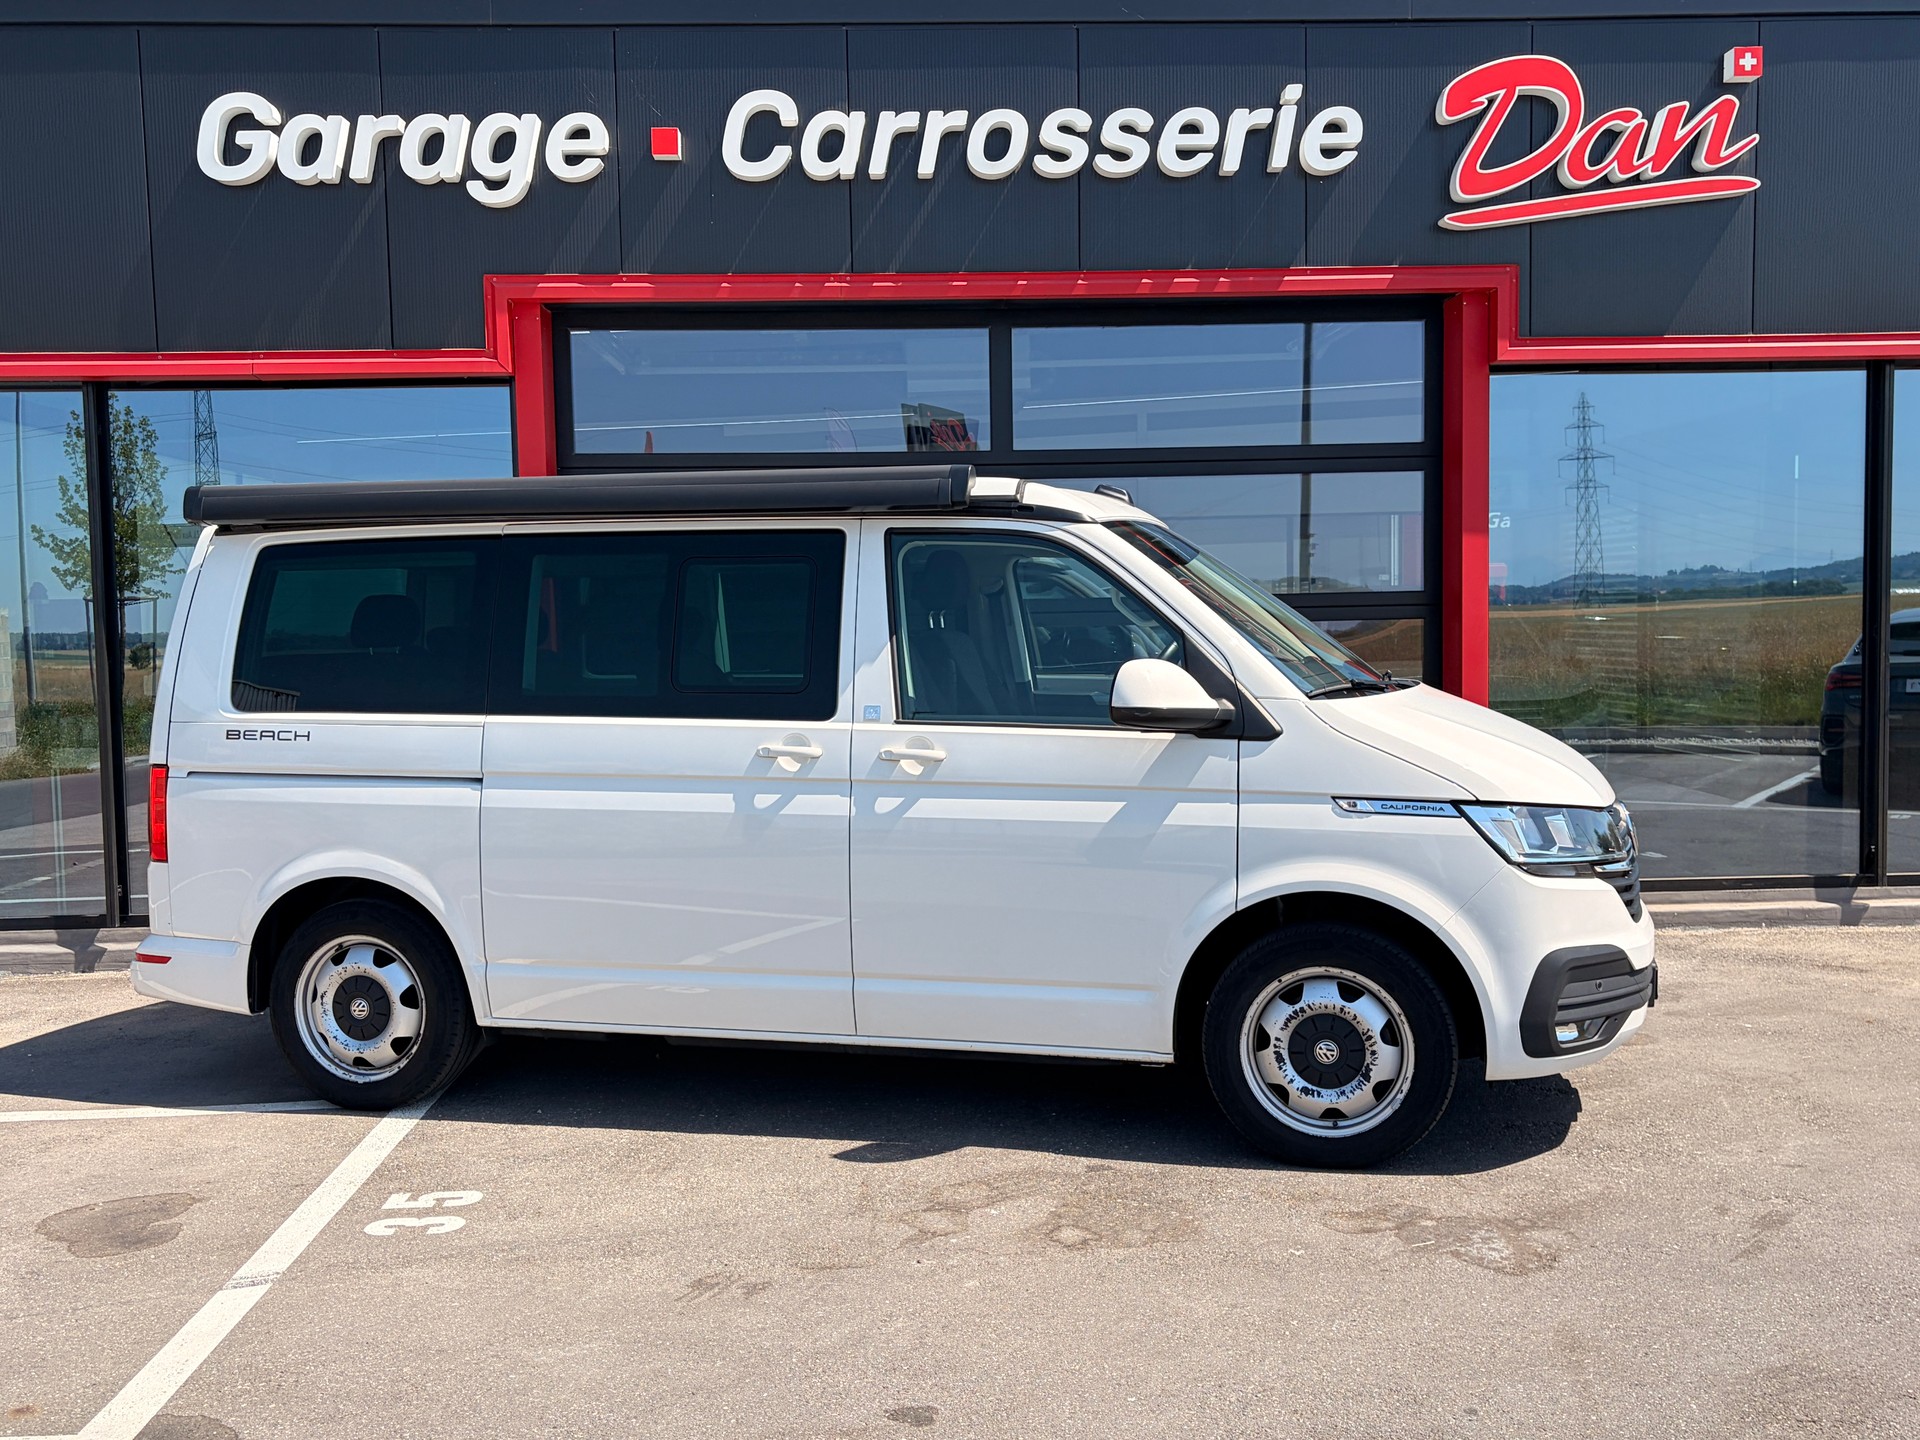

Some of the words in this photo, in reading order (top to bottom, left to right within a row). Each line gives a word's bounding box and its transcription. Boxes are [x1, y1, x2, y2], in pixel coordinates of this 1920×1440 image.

[197, 91, 610, 209] Garage
[721, 83, 1363, 182] Carrosserie
[225, 729, 311, 742] BEACH
[1380, 803, 1446, 813] CALIFORNIA
[363, 1190, 484, 1236] 35
